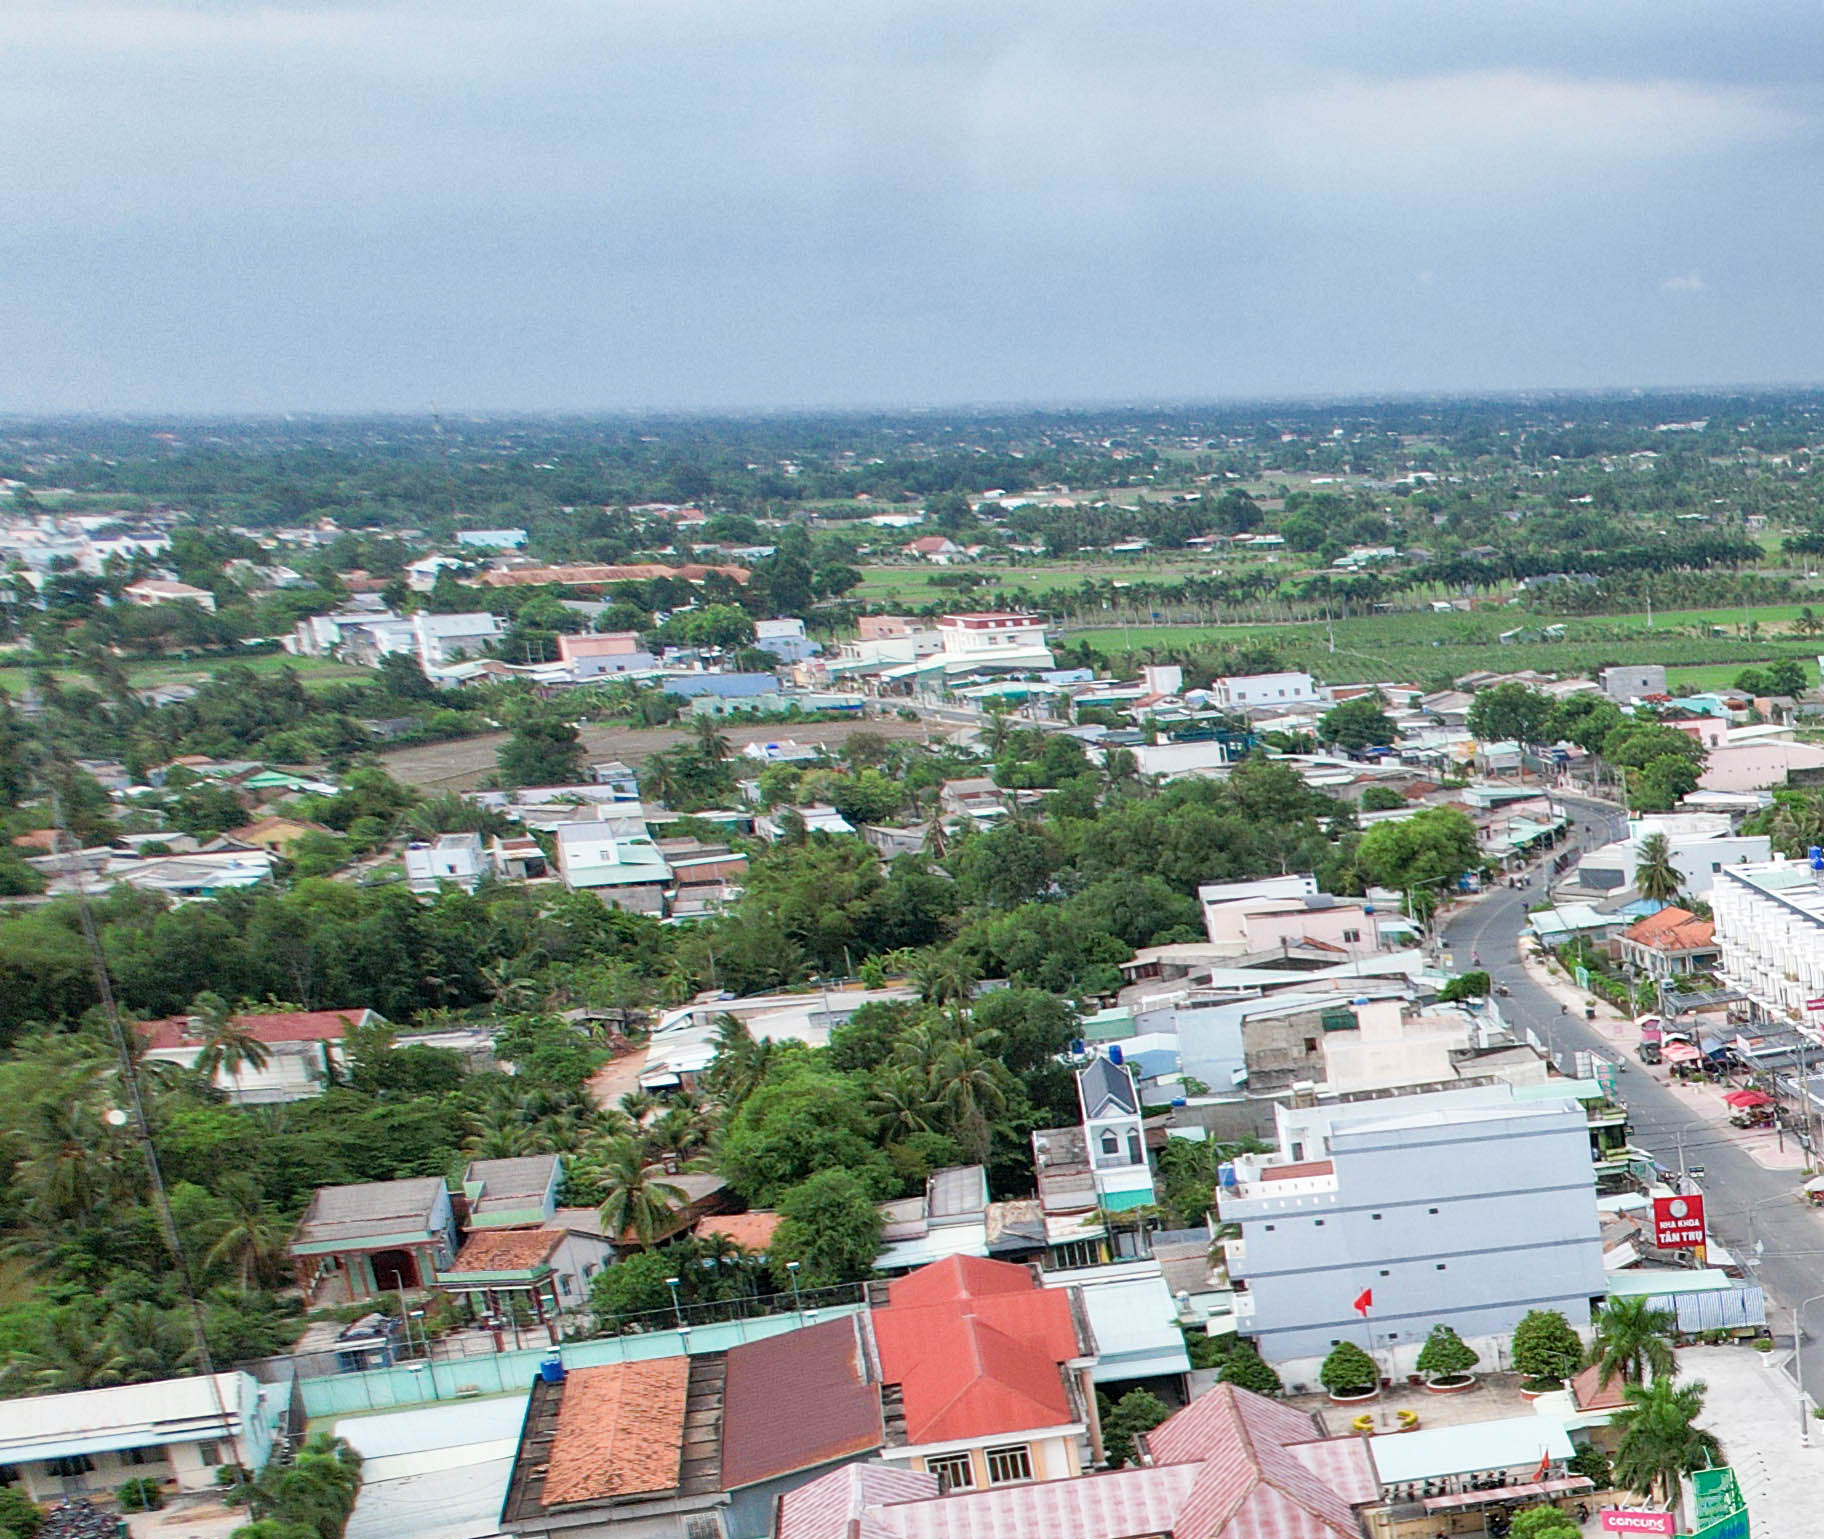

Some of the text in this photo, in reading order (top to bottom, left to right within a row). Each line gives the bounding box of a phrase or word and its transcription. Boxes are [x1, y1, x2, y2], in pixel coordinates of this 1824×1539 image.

[1659, 1218, 1700, 1229] NHA KHOA
[1658, 1231, 1703, 1243] TÂN TRỤ
